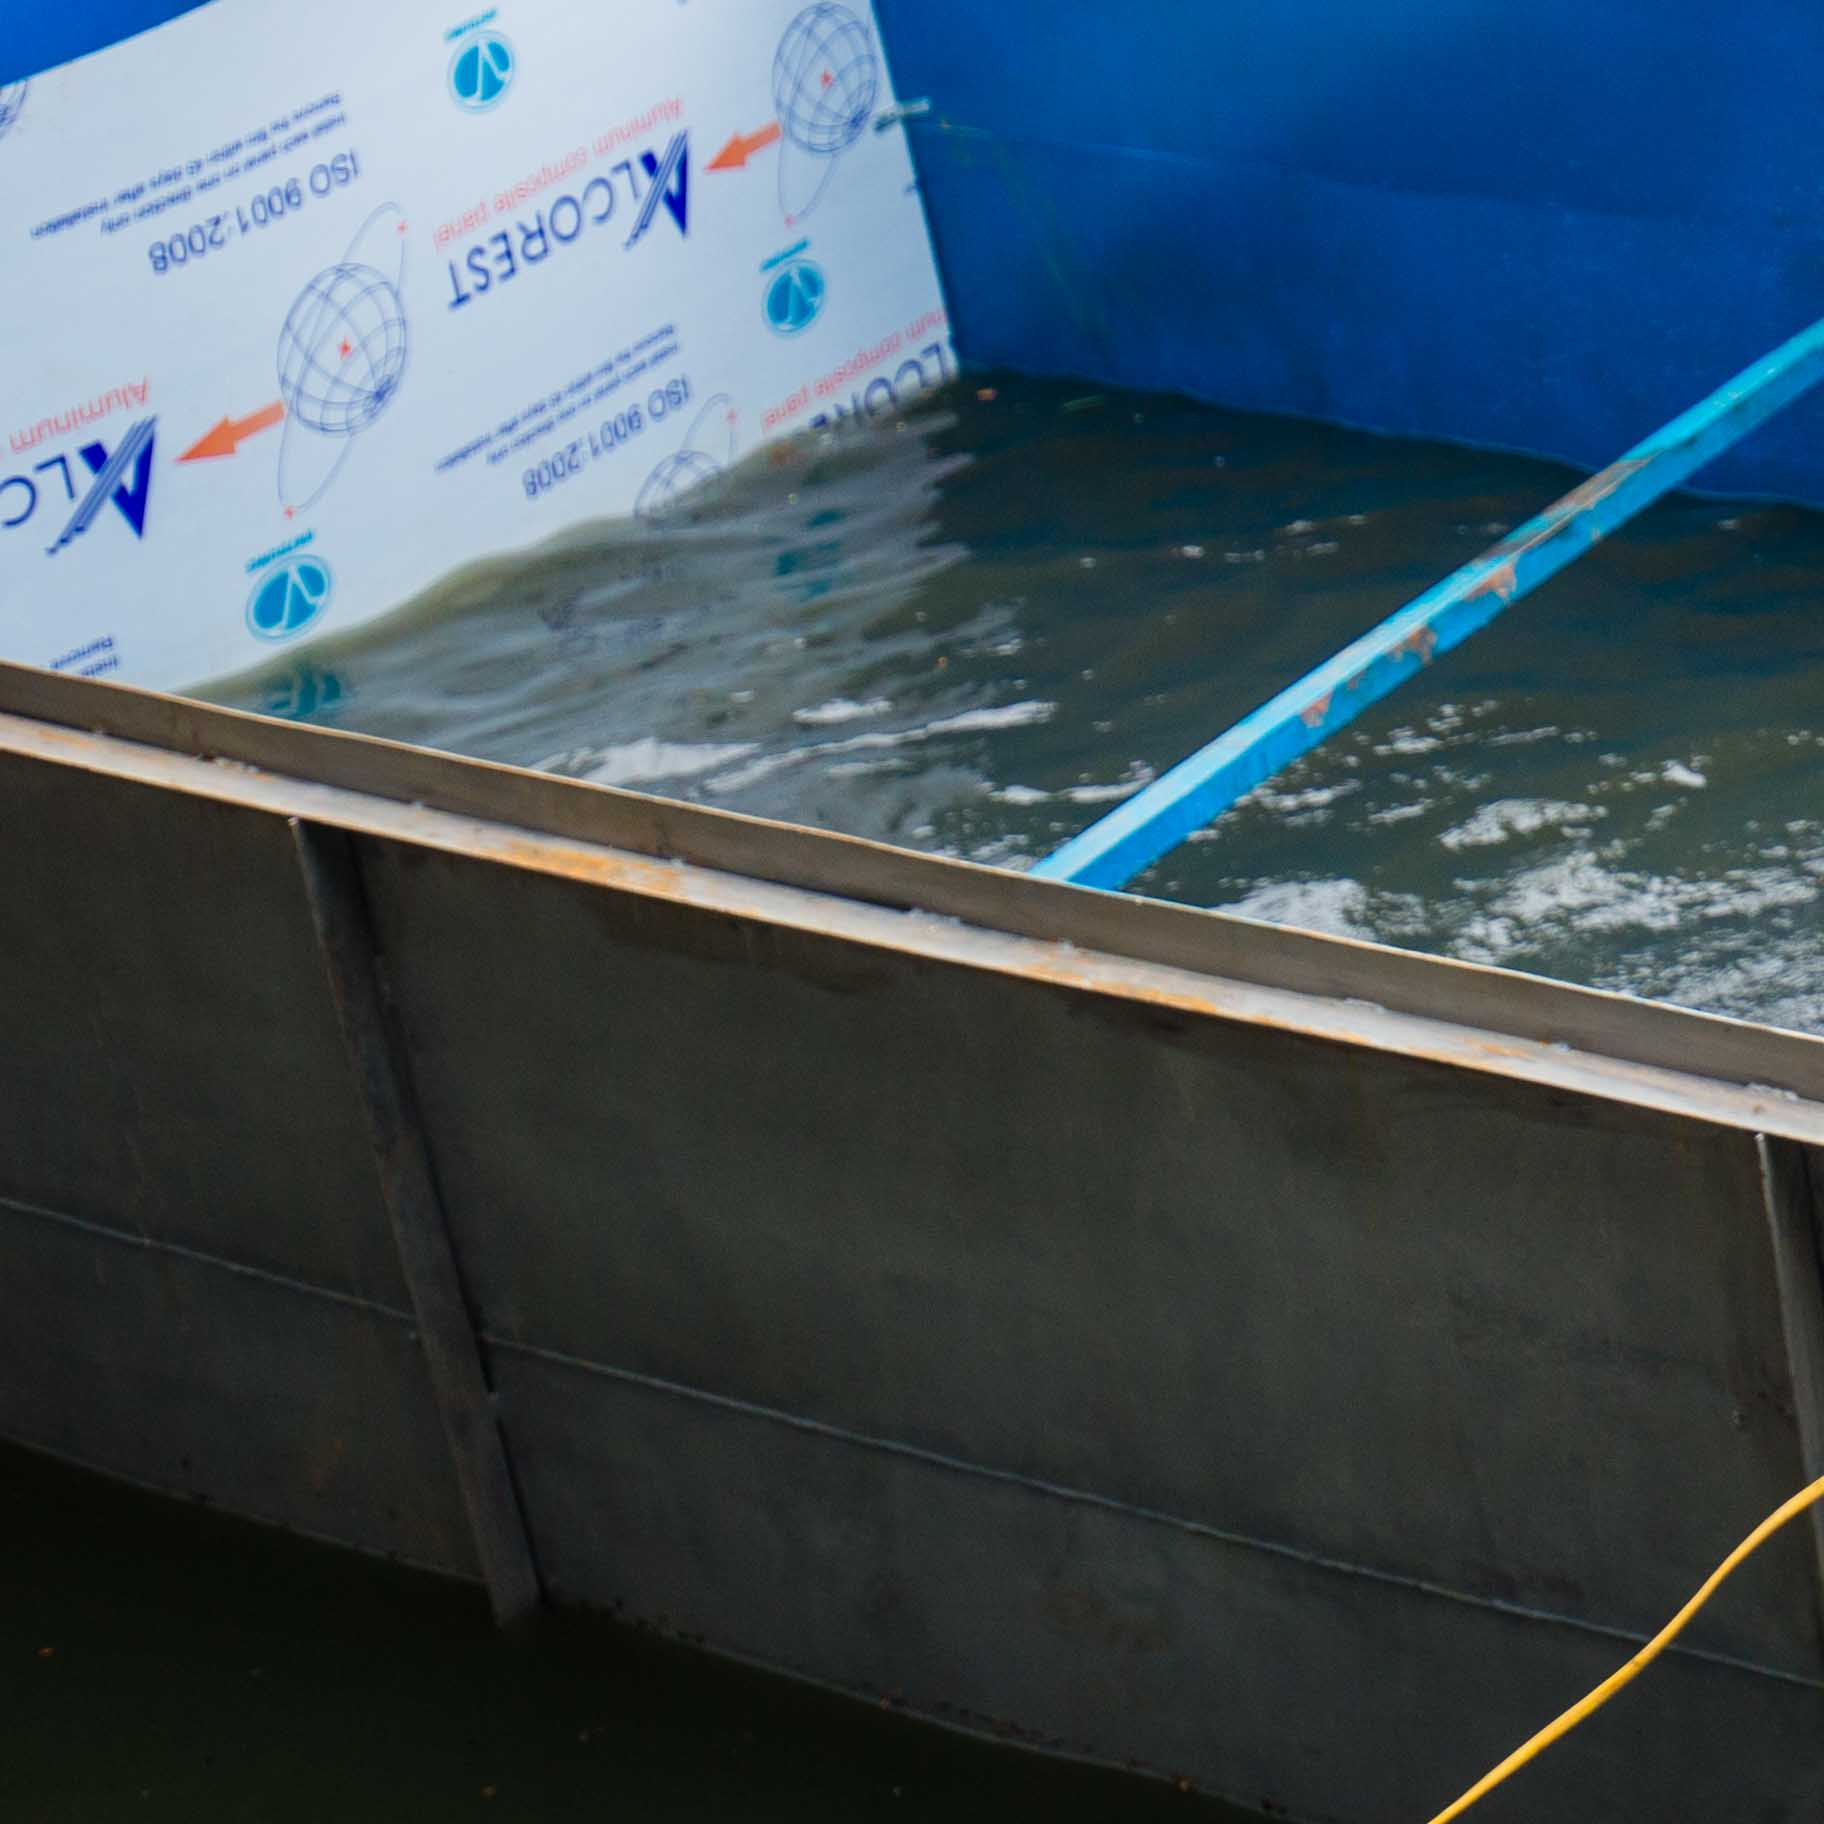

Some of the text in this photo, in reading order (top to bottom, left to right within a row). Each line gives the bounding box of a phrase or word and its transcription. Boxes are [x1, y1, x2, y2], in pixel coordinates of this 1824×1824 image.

[308, 147, 361, 197] ISO
[447, 127, 688, 312] ALCOREST
[9, 374, 150, 455] Aluminum
[647, 374, 692, 423] ISO
